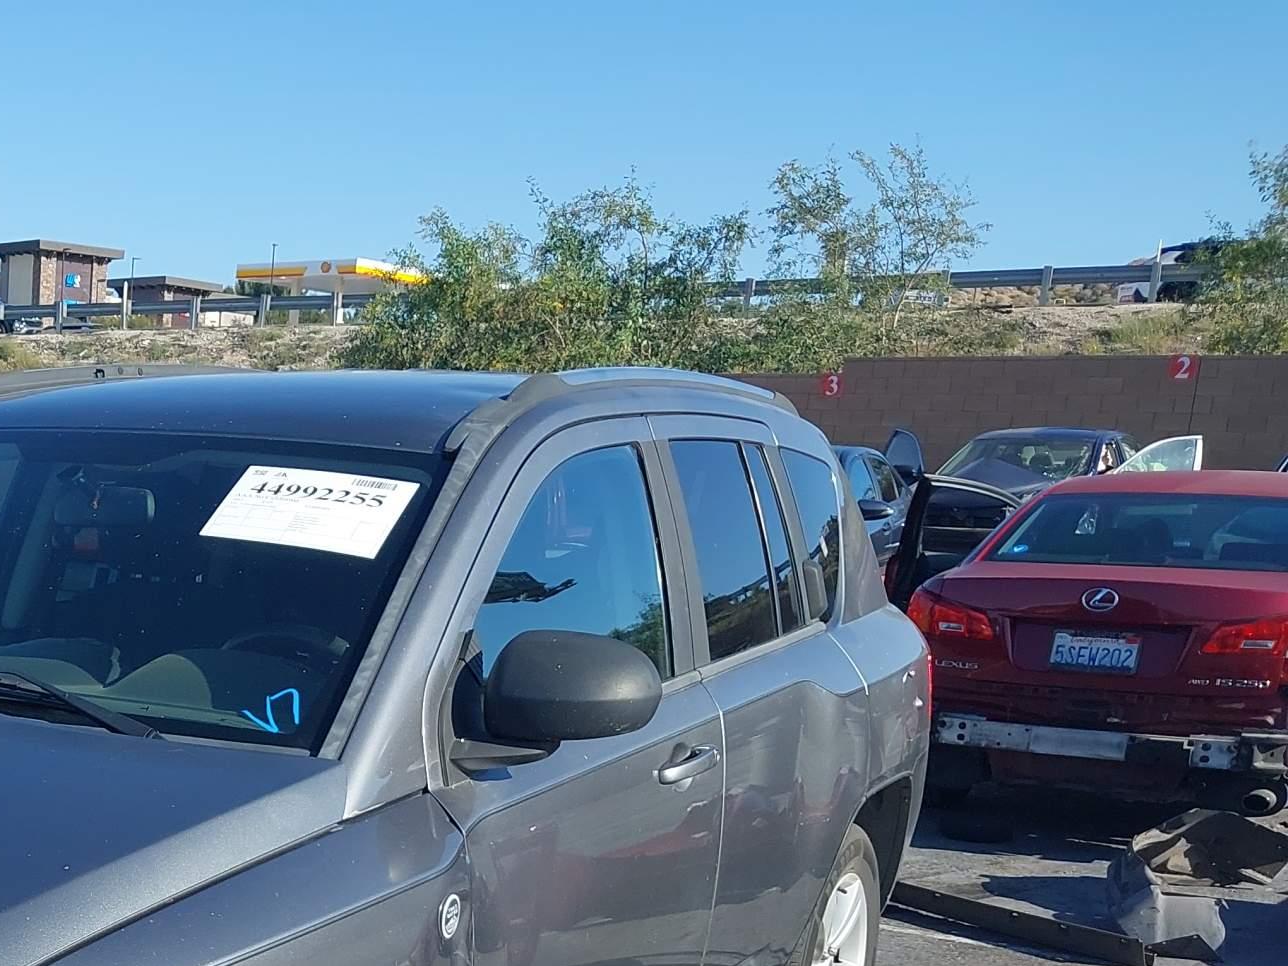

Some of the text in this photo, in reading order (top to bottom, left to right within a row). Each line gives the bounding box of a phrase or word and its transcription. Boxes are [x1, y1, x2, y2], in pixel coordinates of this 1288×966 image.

[1174, 356, 1191, 379] 2
[825, 375, 838, 396] 3
[250, 481, 388, 508] 44992255
[934, 659, 979, 670] LEXUS
[1054, 643, 1134, 667] 5SEW202
